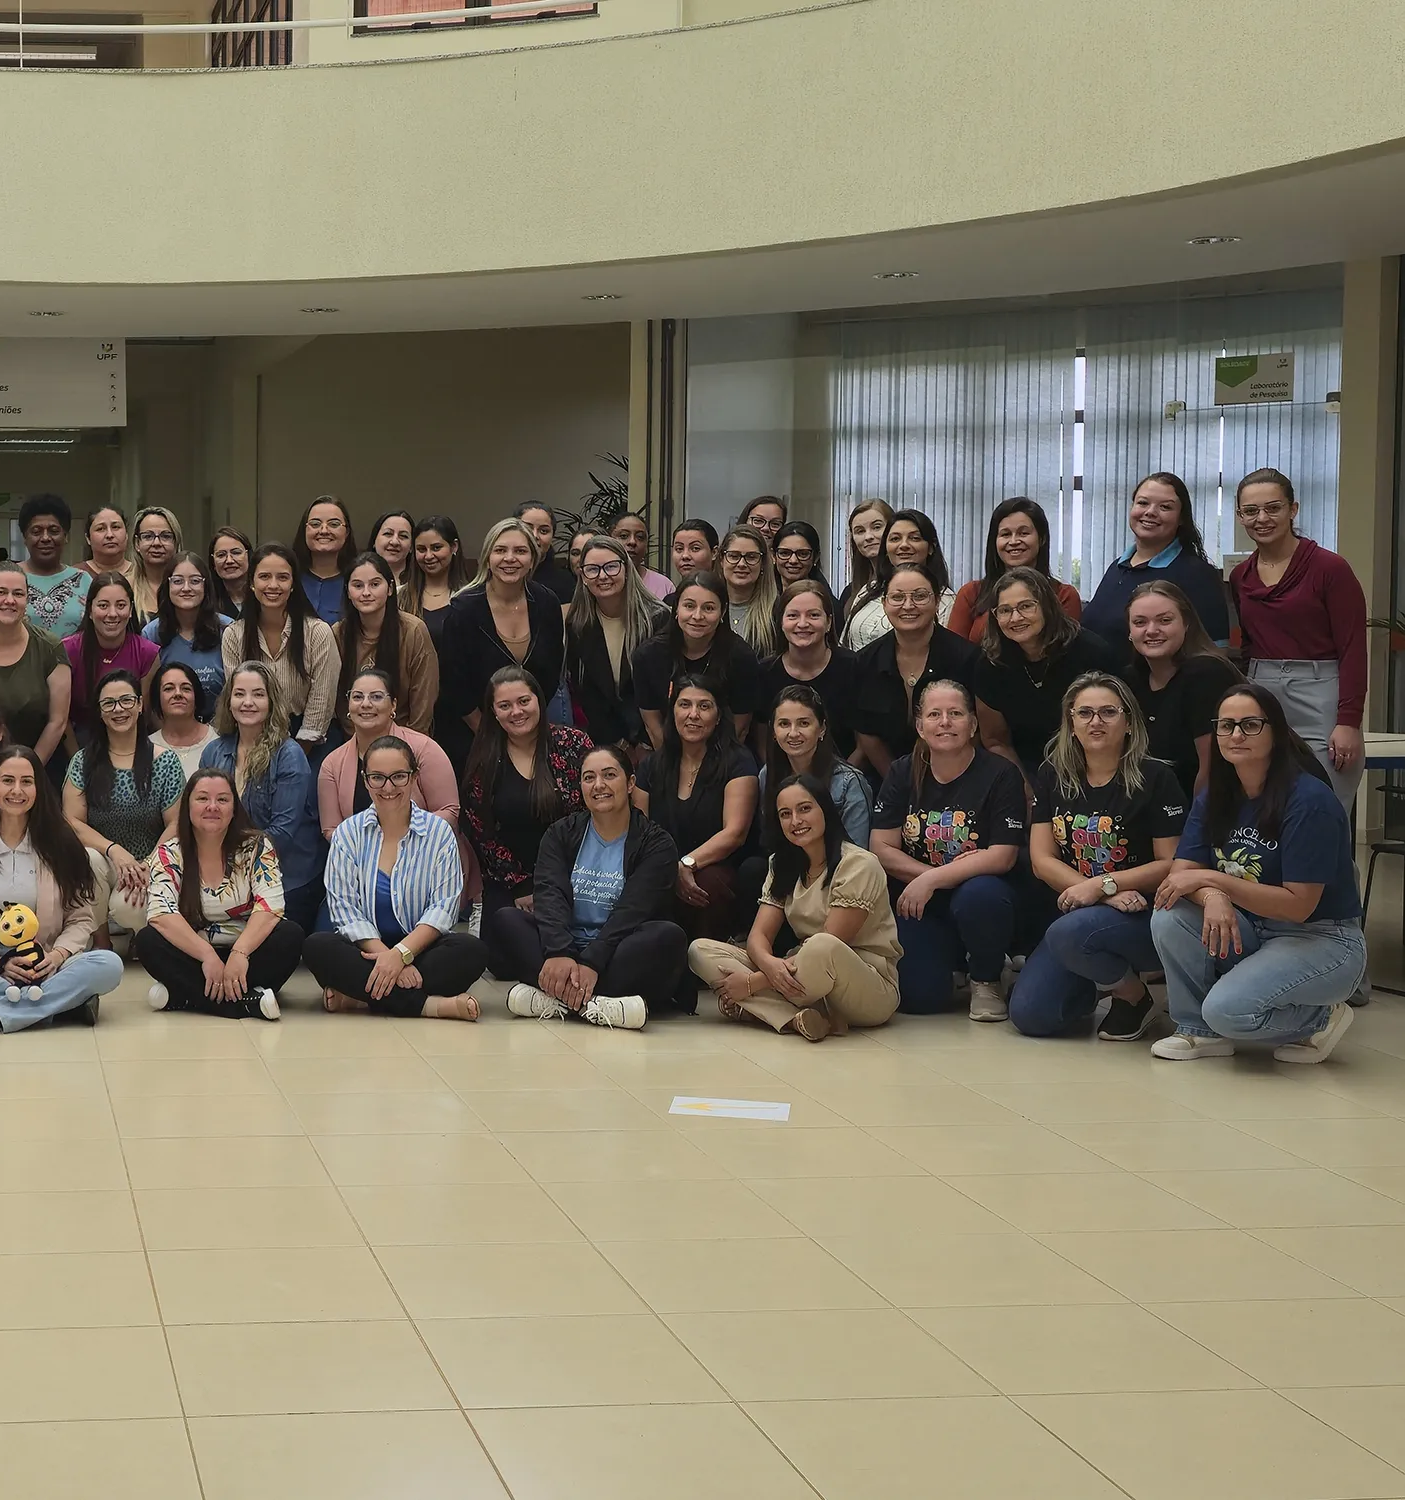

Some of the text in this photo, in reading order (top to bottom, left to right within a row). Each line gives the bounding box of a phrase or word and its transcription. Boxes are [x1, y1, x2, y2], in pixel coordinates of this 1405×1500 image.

[1250, 381, 1289, 390] Laboratório
[1249, 390, 1289, 399] de Pesquisa
